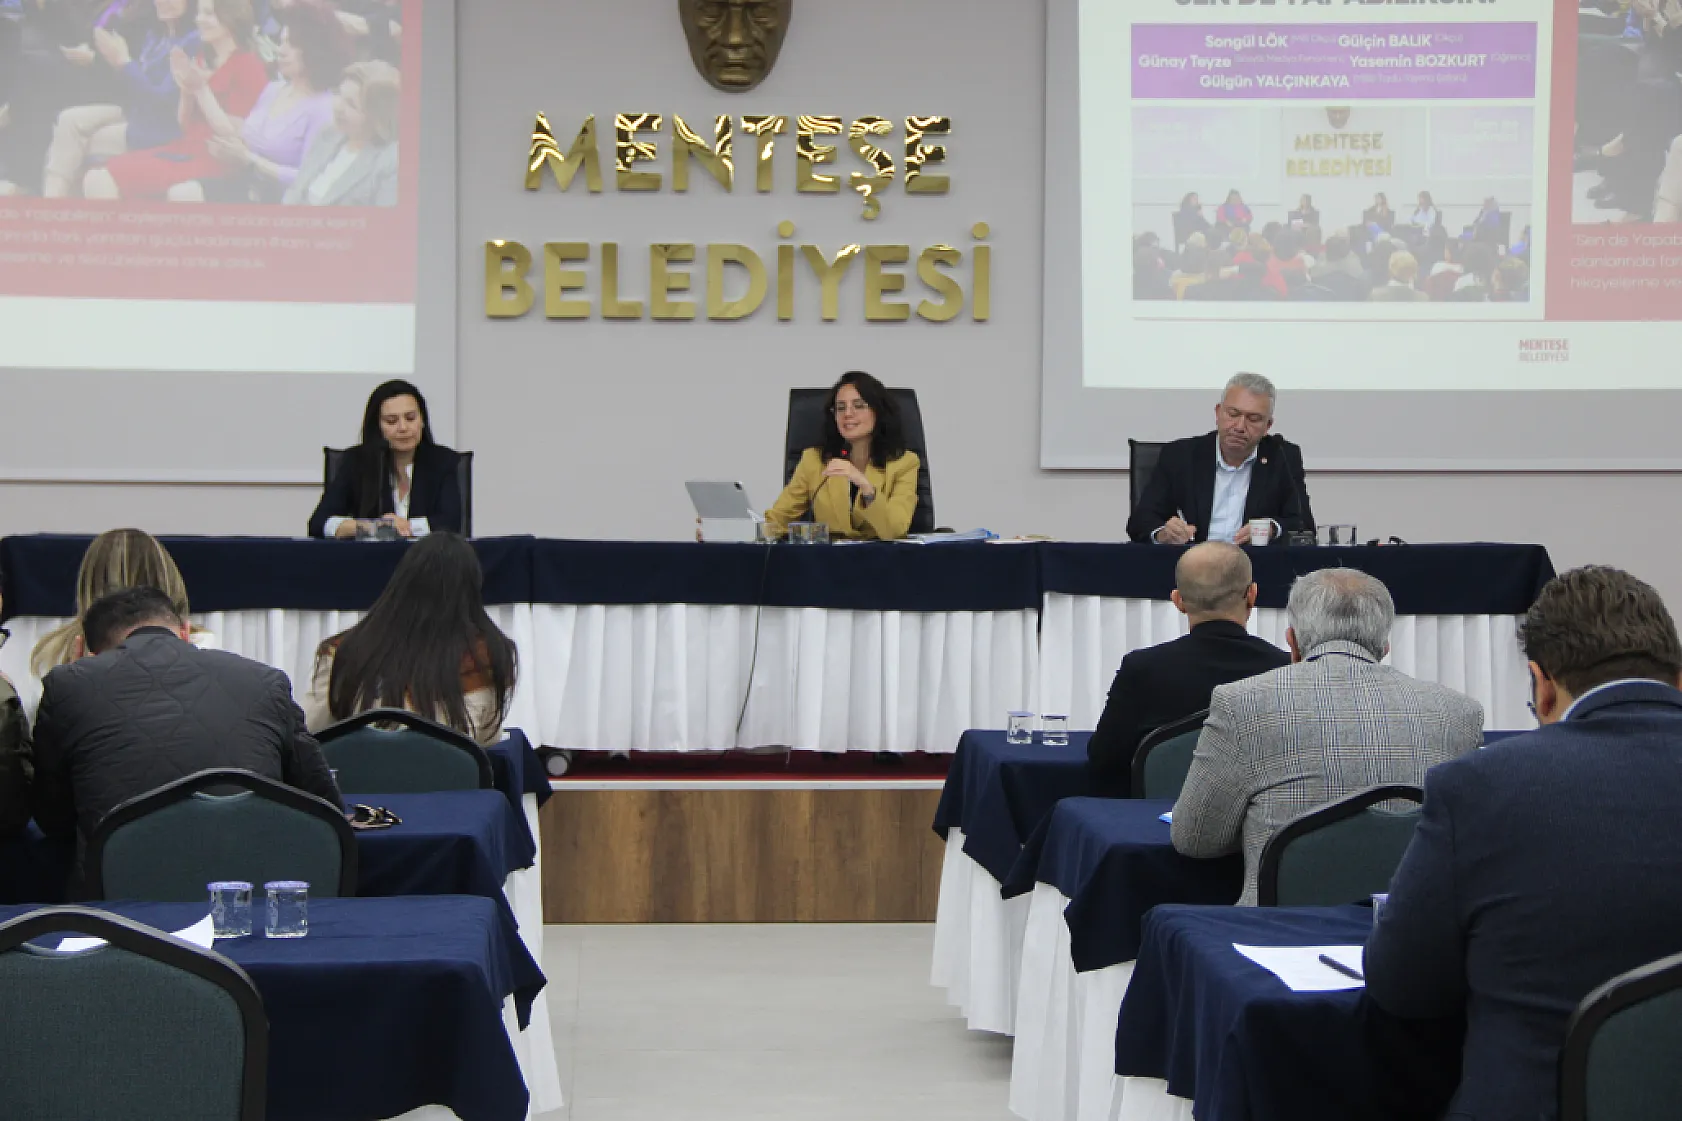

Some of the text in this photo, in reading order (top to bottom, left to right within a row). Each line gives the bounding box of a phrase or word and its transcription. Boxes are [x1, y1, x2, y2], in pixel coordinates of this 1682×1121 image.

[1204, 34, 1255, 51] Songül
[1258, 31, 1289, 48] LÖK
[1338, 33, 1386, 51] Gülçin
[1388, 33, 1433, 48] BALIK
[1138, 53, 1187, 70] Günay
[1350, 53, 1412, 68] Yasemin
[1415, 53, 1488, 68] BOZKURT
[1200, 74, 1252, 91] Gülgün
[1256, 74, 1350, 91] YALÇINKAYA
[1295, 132, 1384, 154] MENTEŞE
[524, 111, 952, 220] MENTEŞE
[1286, 154, 1392, 177] BELEDİYESİ
[484, 220, 991, 321] BELEDİYESİ
